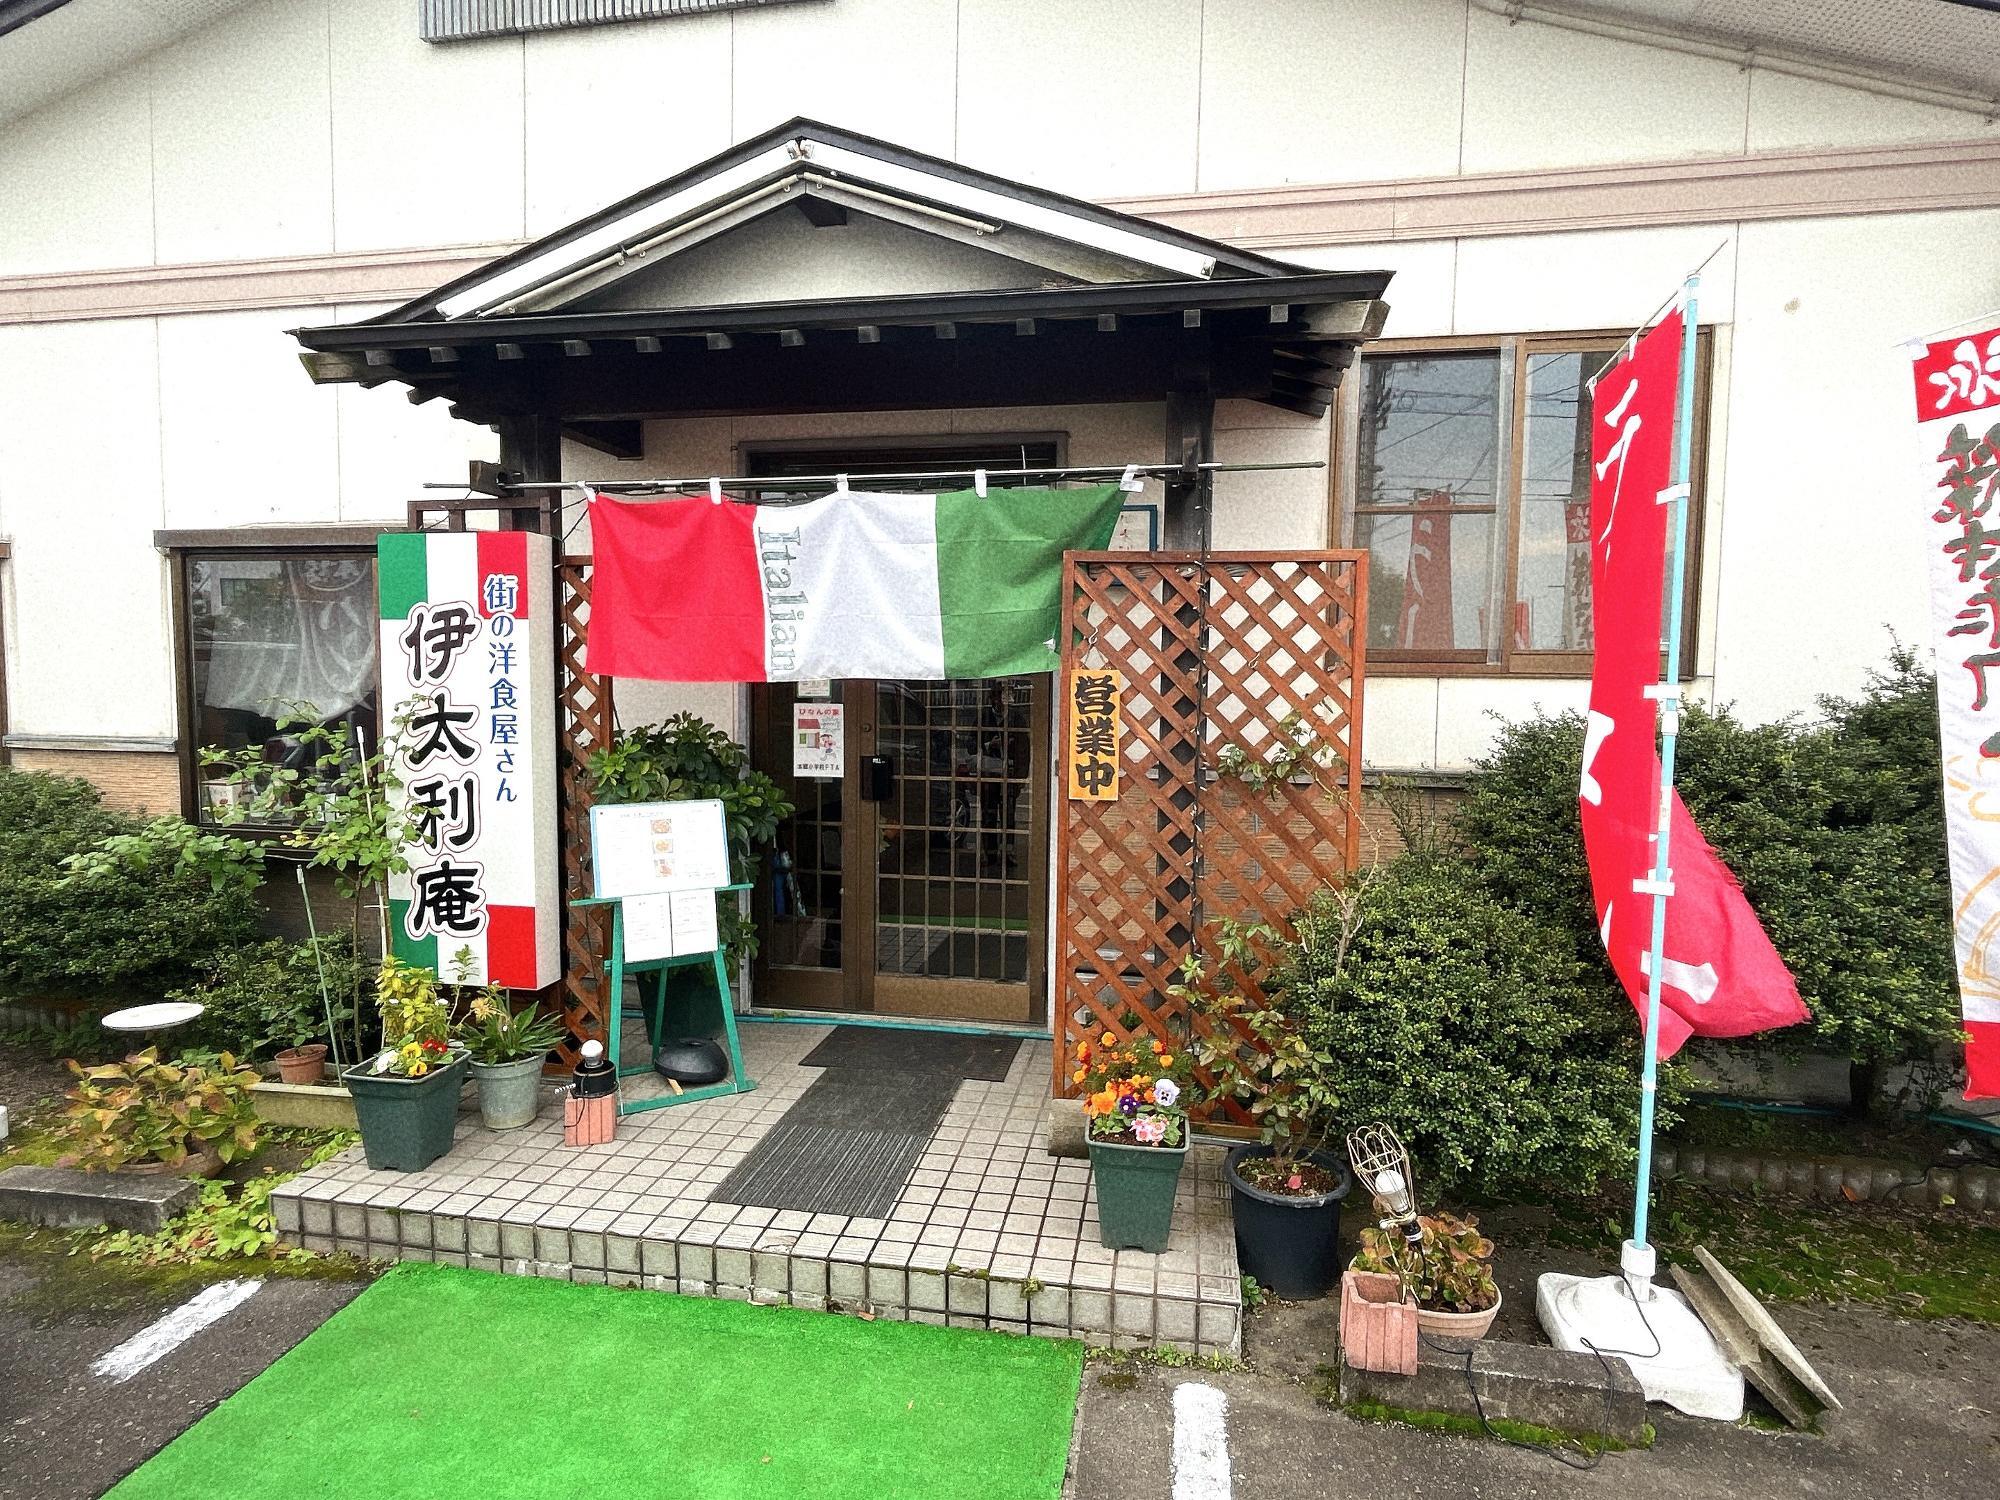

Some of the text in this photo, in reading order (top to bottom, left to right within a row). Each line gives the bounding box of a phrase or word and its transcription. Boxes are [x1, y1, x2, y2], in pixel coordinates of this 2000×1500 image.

[486, 576, 519, 803] 街の洋食屋さん
[758, 526, 809, 676] Italian
[405, 606, 481, 932] 伊太利庵
[1075, 675, 1117, 796] 営業中
